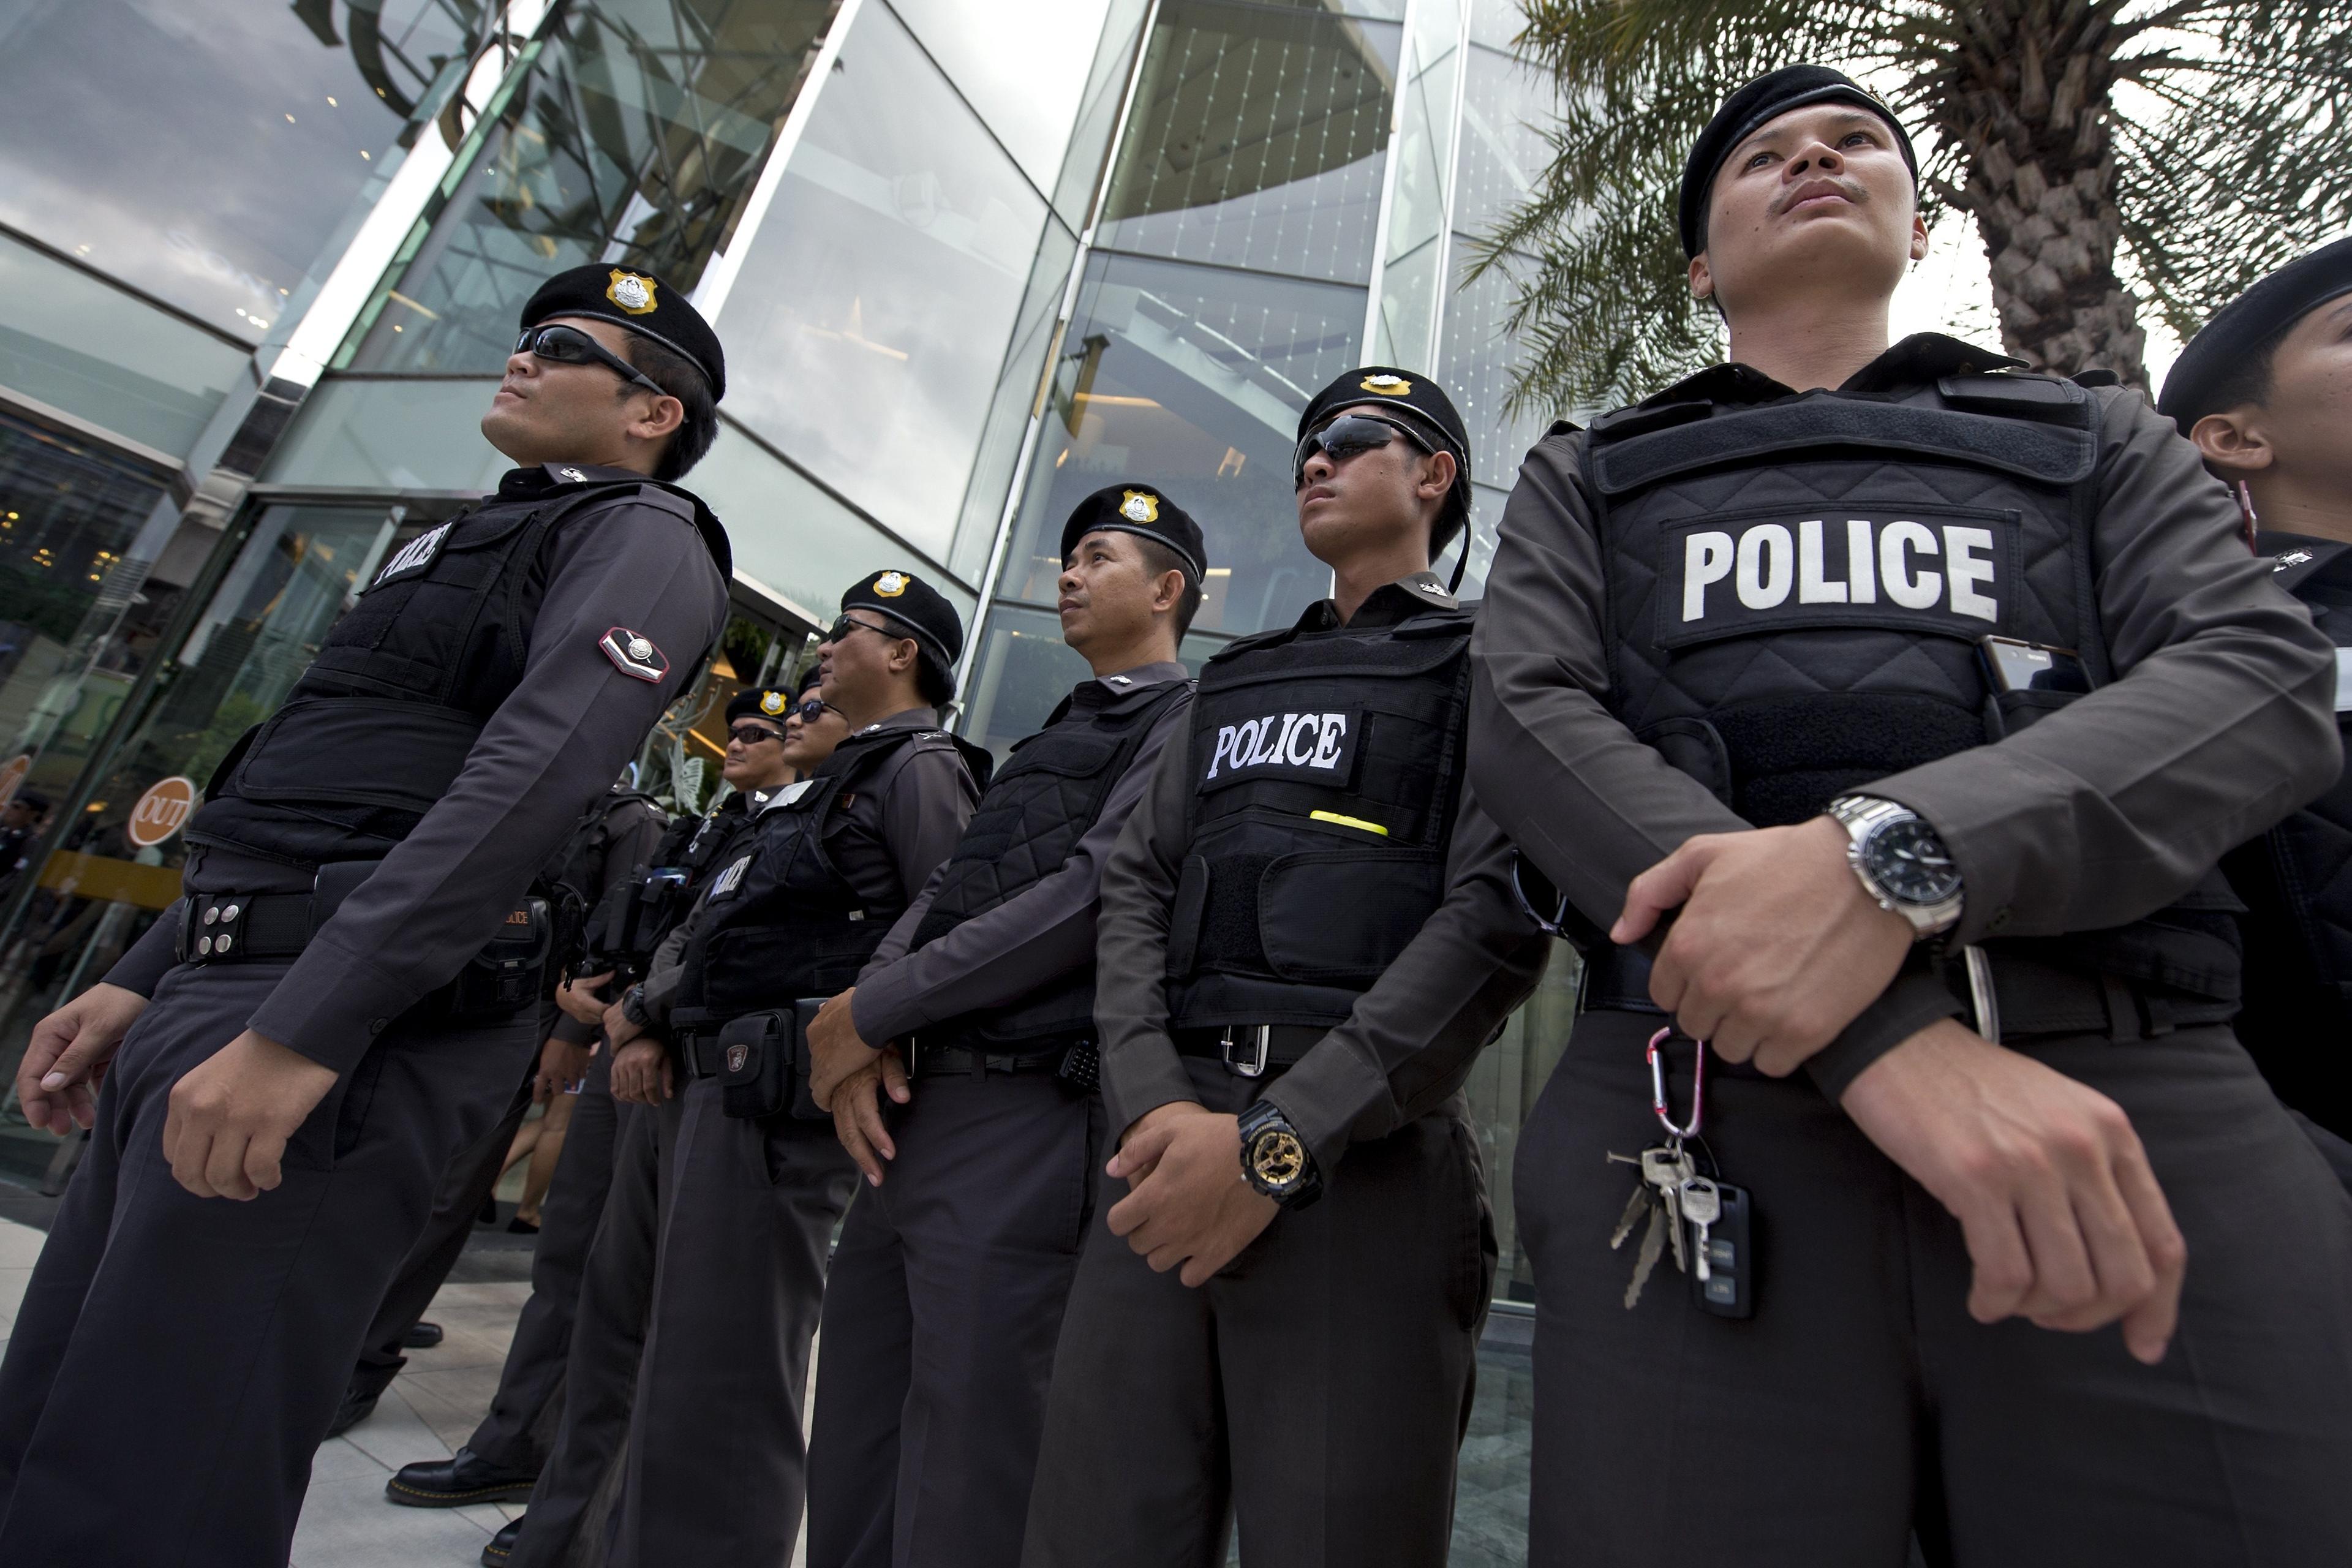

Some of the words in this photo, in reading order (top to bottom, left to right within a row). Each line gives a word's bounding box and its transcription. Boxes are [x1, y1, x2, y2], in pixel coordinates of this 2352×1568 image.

[1683, 520, 1997, 623] POLICE
[1207, 714, 1346, 780] POLICE
[137, 796, 190, 827] OUT
